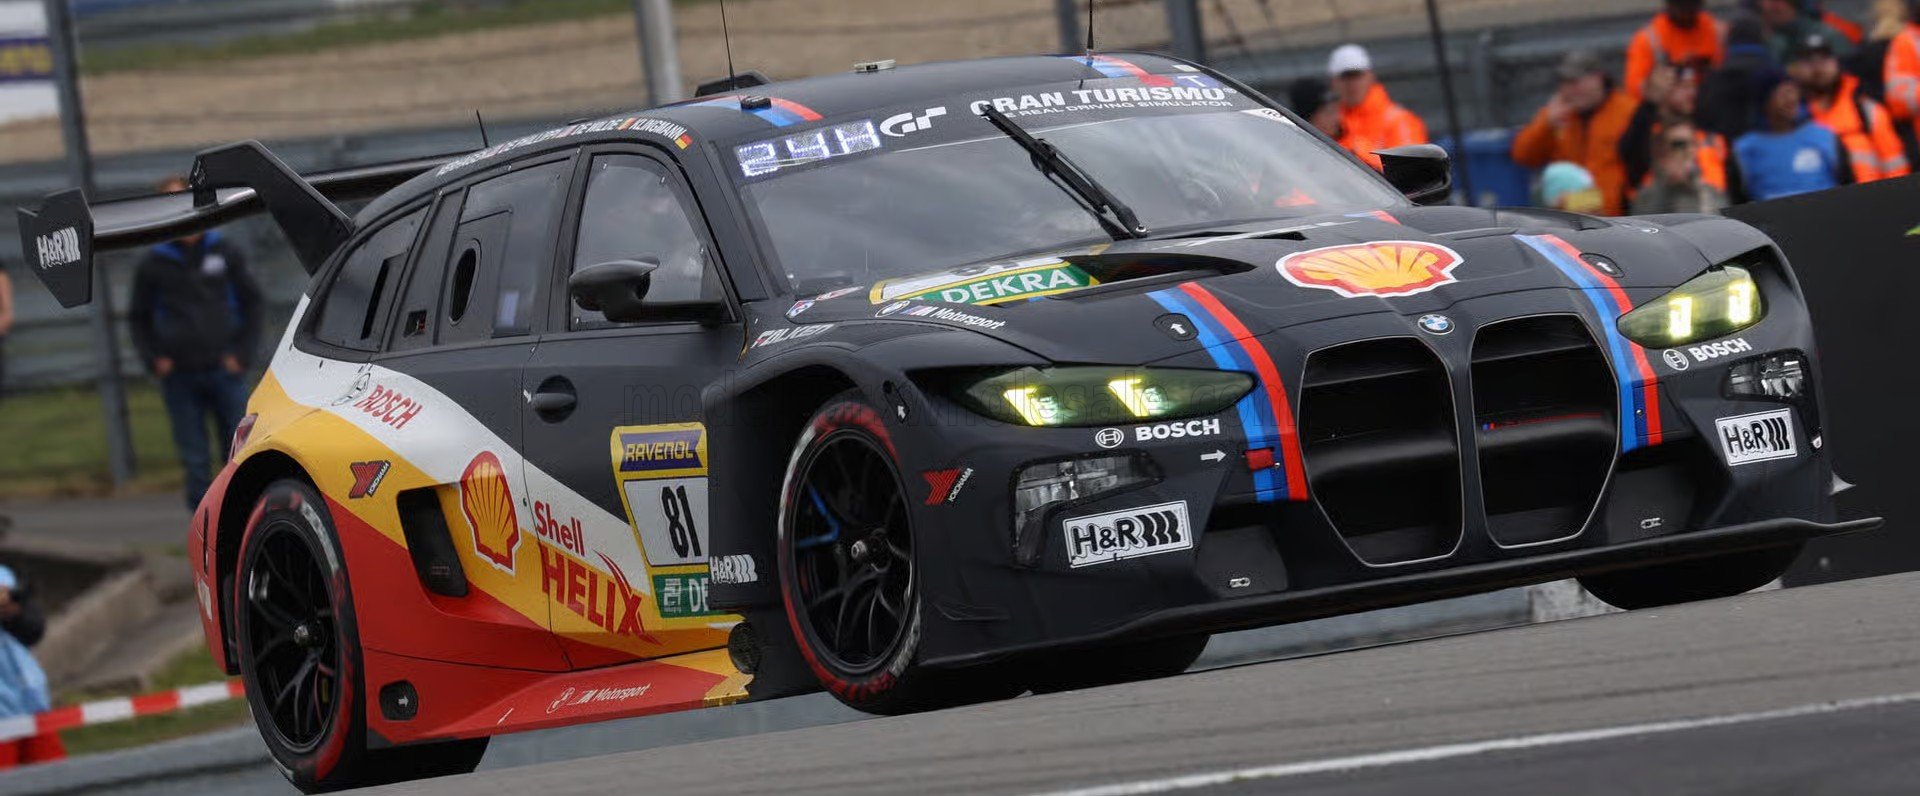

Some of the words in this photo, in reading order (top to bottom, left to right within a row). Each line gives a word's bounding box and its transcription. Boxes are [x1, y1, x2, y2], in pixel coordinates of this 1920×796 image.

[970, 92, 1066, 116] GRAN
[1019, 107, 1065, 116] REAL
[1065, 102, 1135, 111] DRIVING
[941, 269, 1078, 304] DEKRA
[933, 306, 1006, 330] Motorsport
[1688, 338, 1752, 362] BOSCH
[353, 384, 423, 430] BOSCH
[1135, 418, 1221, 441] BOSCH
[624, 440, 694, 462] RAVENOL
[534, 500, 585, 557] Shell
[661, 485, 702, 558] 81
[538, 544, 647, 638] HELIX
[594, 683, 651, 701] Motorsport
